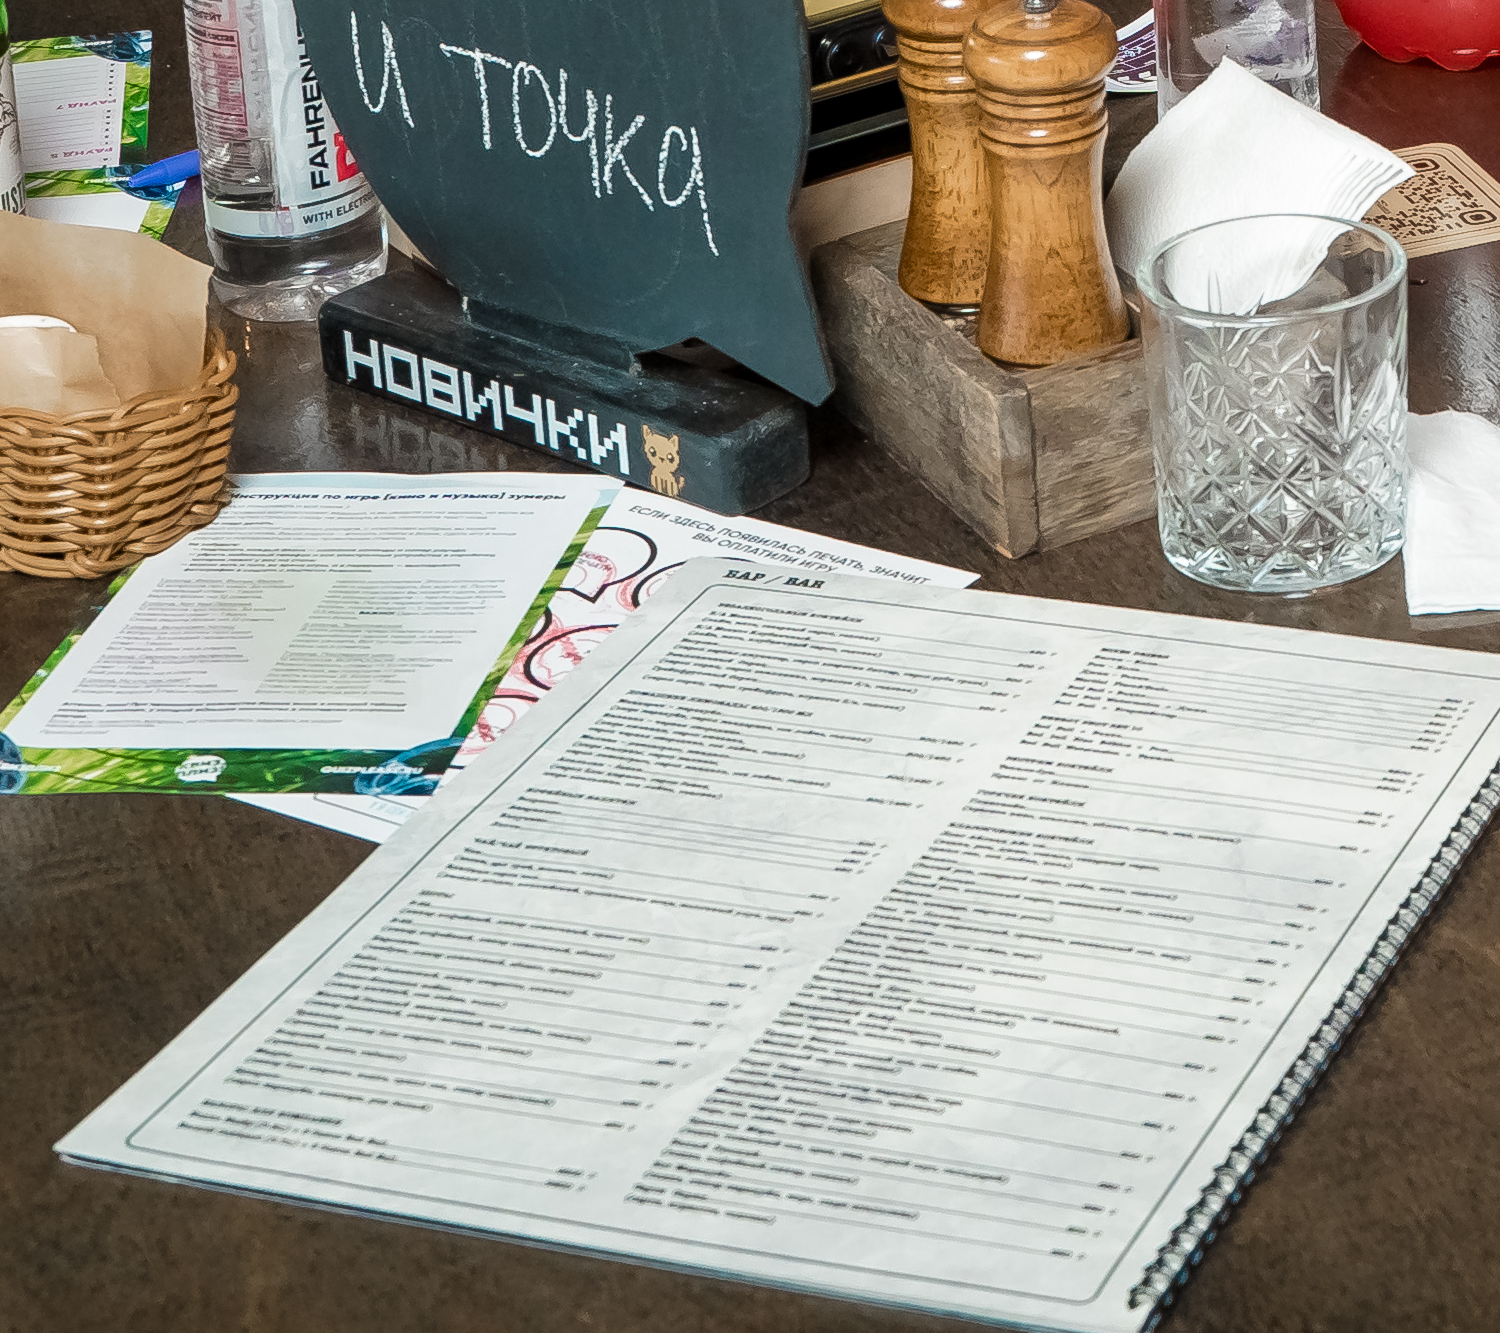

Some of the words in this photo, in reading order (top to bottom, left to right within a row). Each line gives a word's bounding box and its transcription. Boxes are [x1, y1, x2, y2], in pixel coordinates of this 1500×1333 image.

[302, 209, 333, 225] WITH
[343, 329, 632, 475] НОВИЧКИ
[628, 505, 671, 521] ЕСЛИ
[668, 514, 715, 533] ЗДЕСЬ
[717, 526, 807, 556] ПОЯВИЛАСЬ
[809, 550, 865, 572] ПЕЧАТЬ,
[869, 565, 932, 585] ЗНАЧИТ
[691, 532, 717, 545] ВЫ
[718, 537, 798, 565] ОПЛАТИЛИ
[798, 557, 839, 574] ИГРУ
